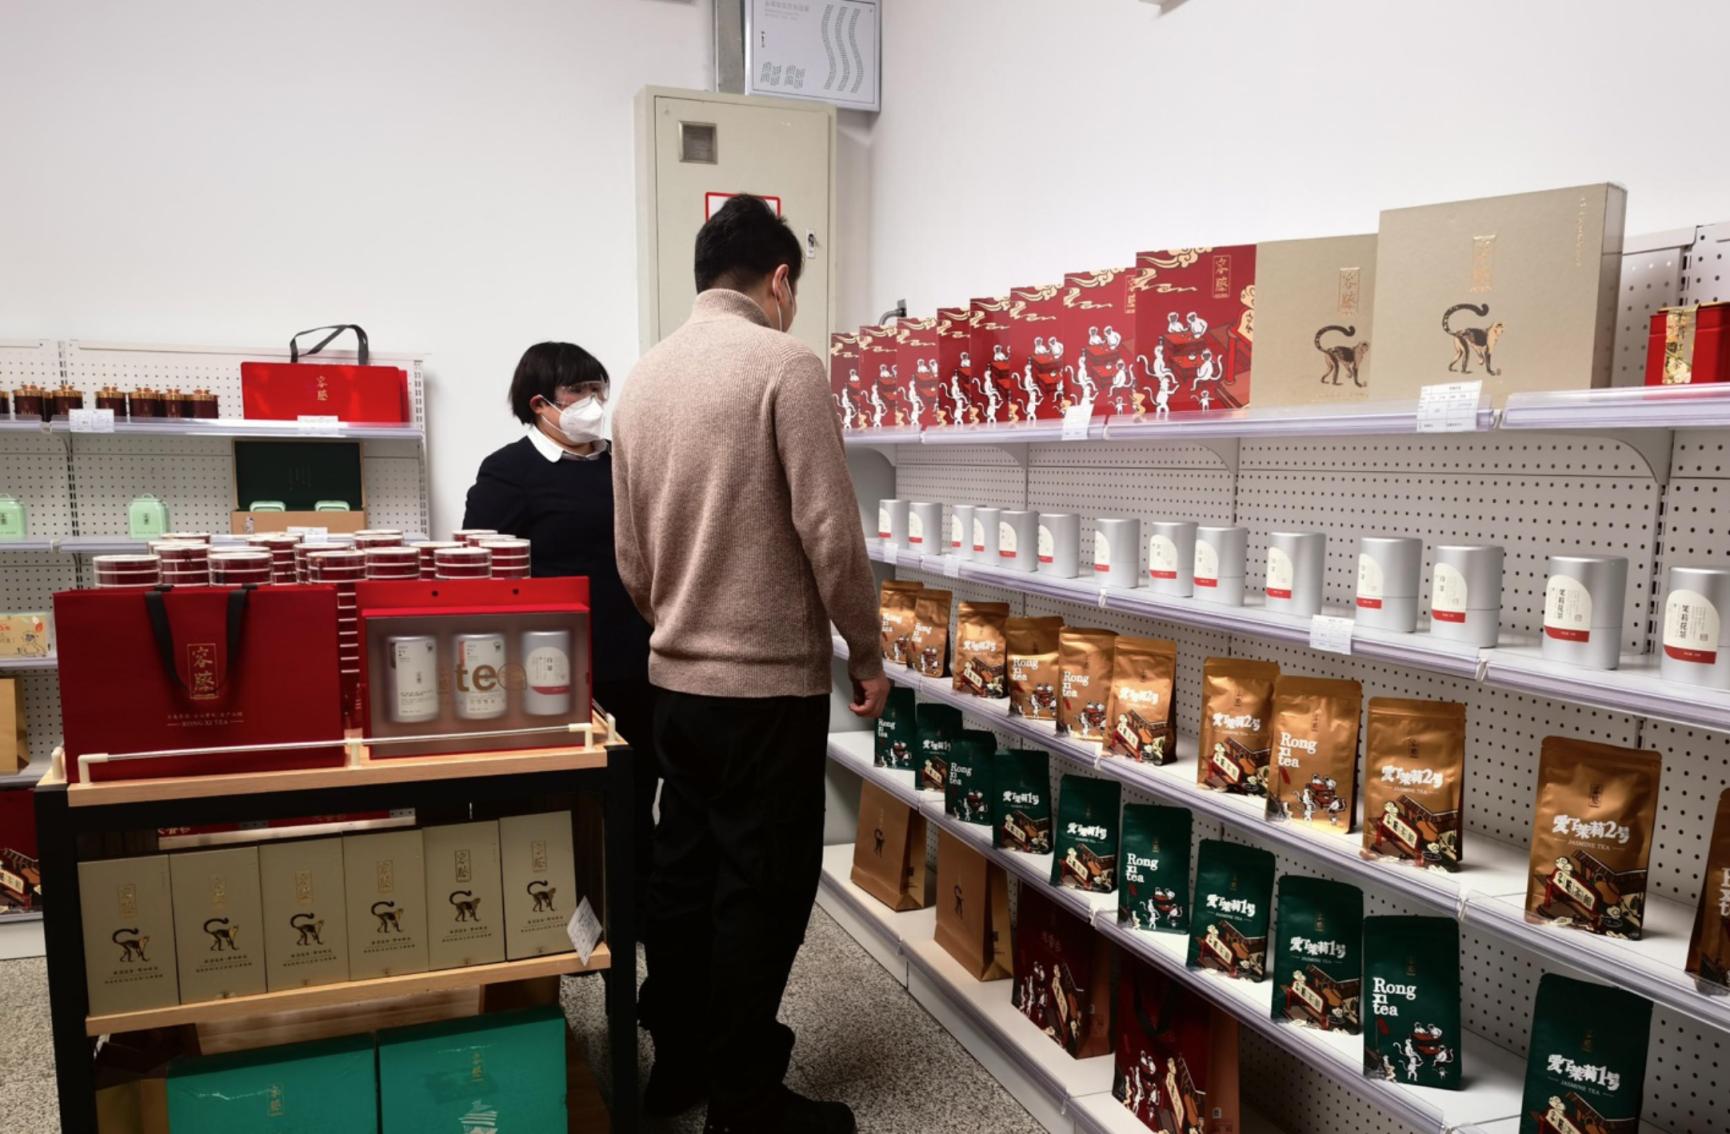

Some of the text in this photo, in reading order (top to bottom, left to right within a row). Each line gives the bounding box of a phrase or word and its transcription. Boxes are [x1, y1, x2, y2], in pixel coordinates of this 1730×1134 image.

[1012, 658, 1039, 672] Rong
[1012, 673, 1028, 681] tea
[1063, 671, 1090, 687] Rong
[1062, 688, 1078, 697] tea
[1279, 732, 1317, 756] Rong
[1278, 755, 1300, 768] tea
[950, 762, 973, 777] Rong
[1126, 853, 1159, 871] Rong
[1126, 872, 1145, 883] tea
[1372, 977, 1417, 1001] Rong
[1373, 1003, 1399, 1017] tea
